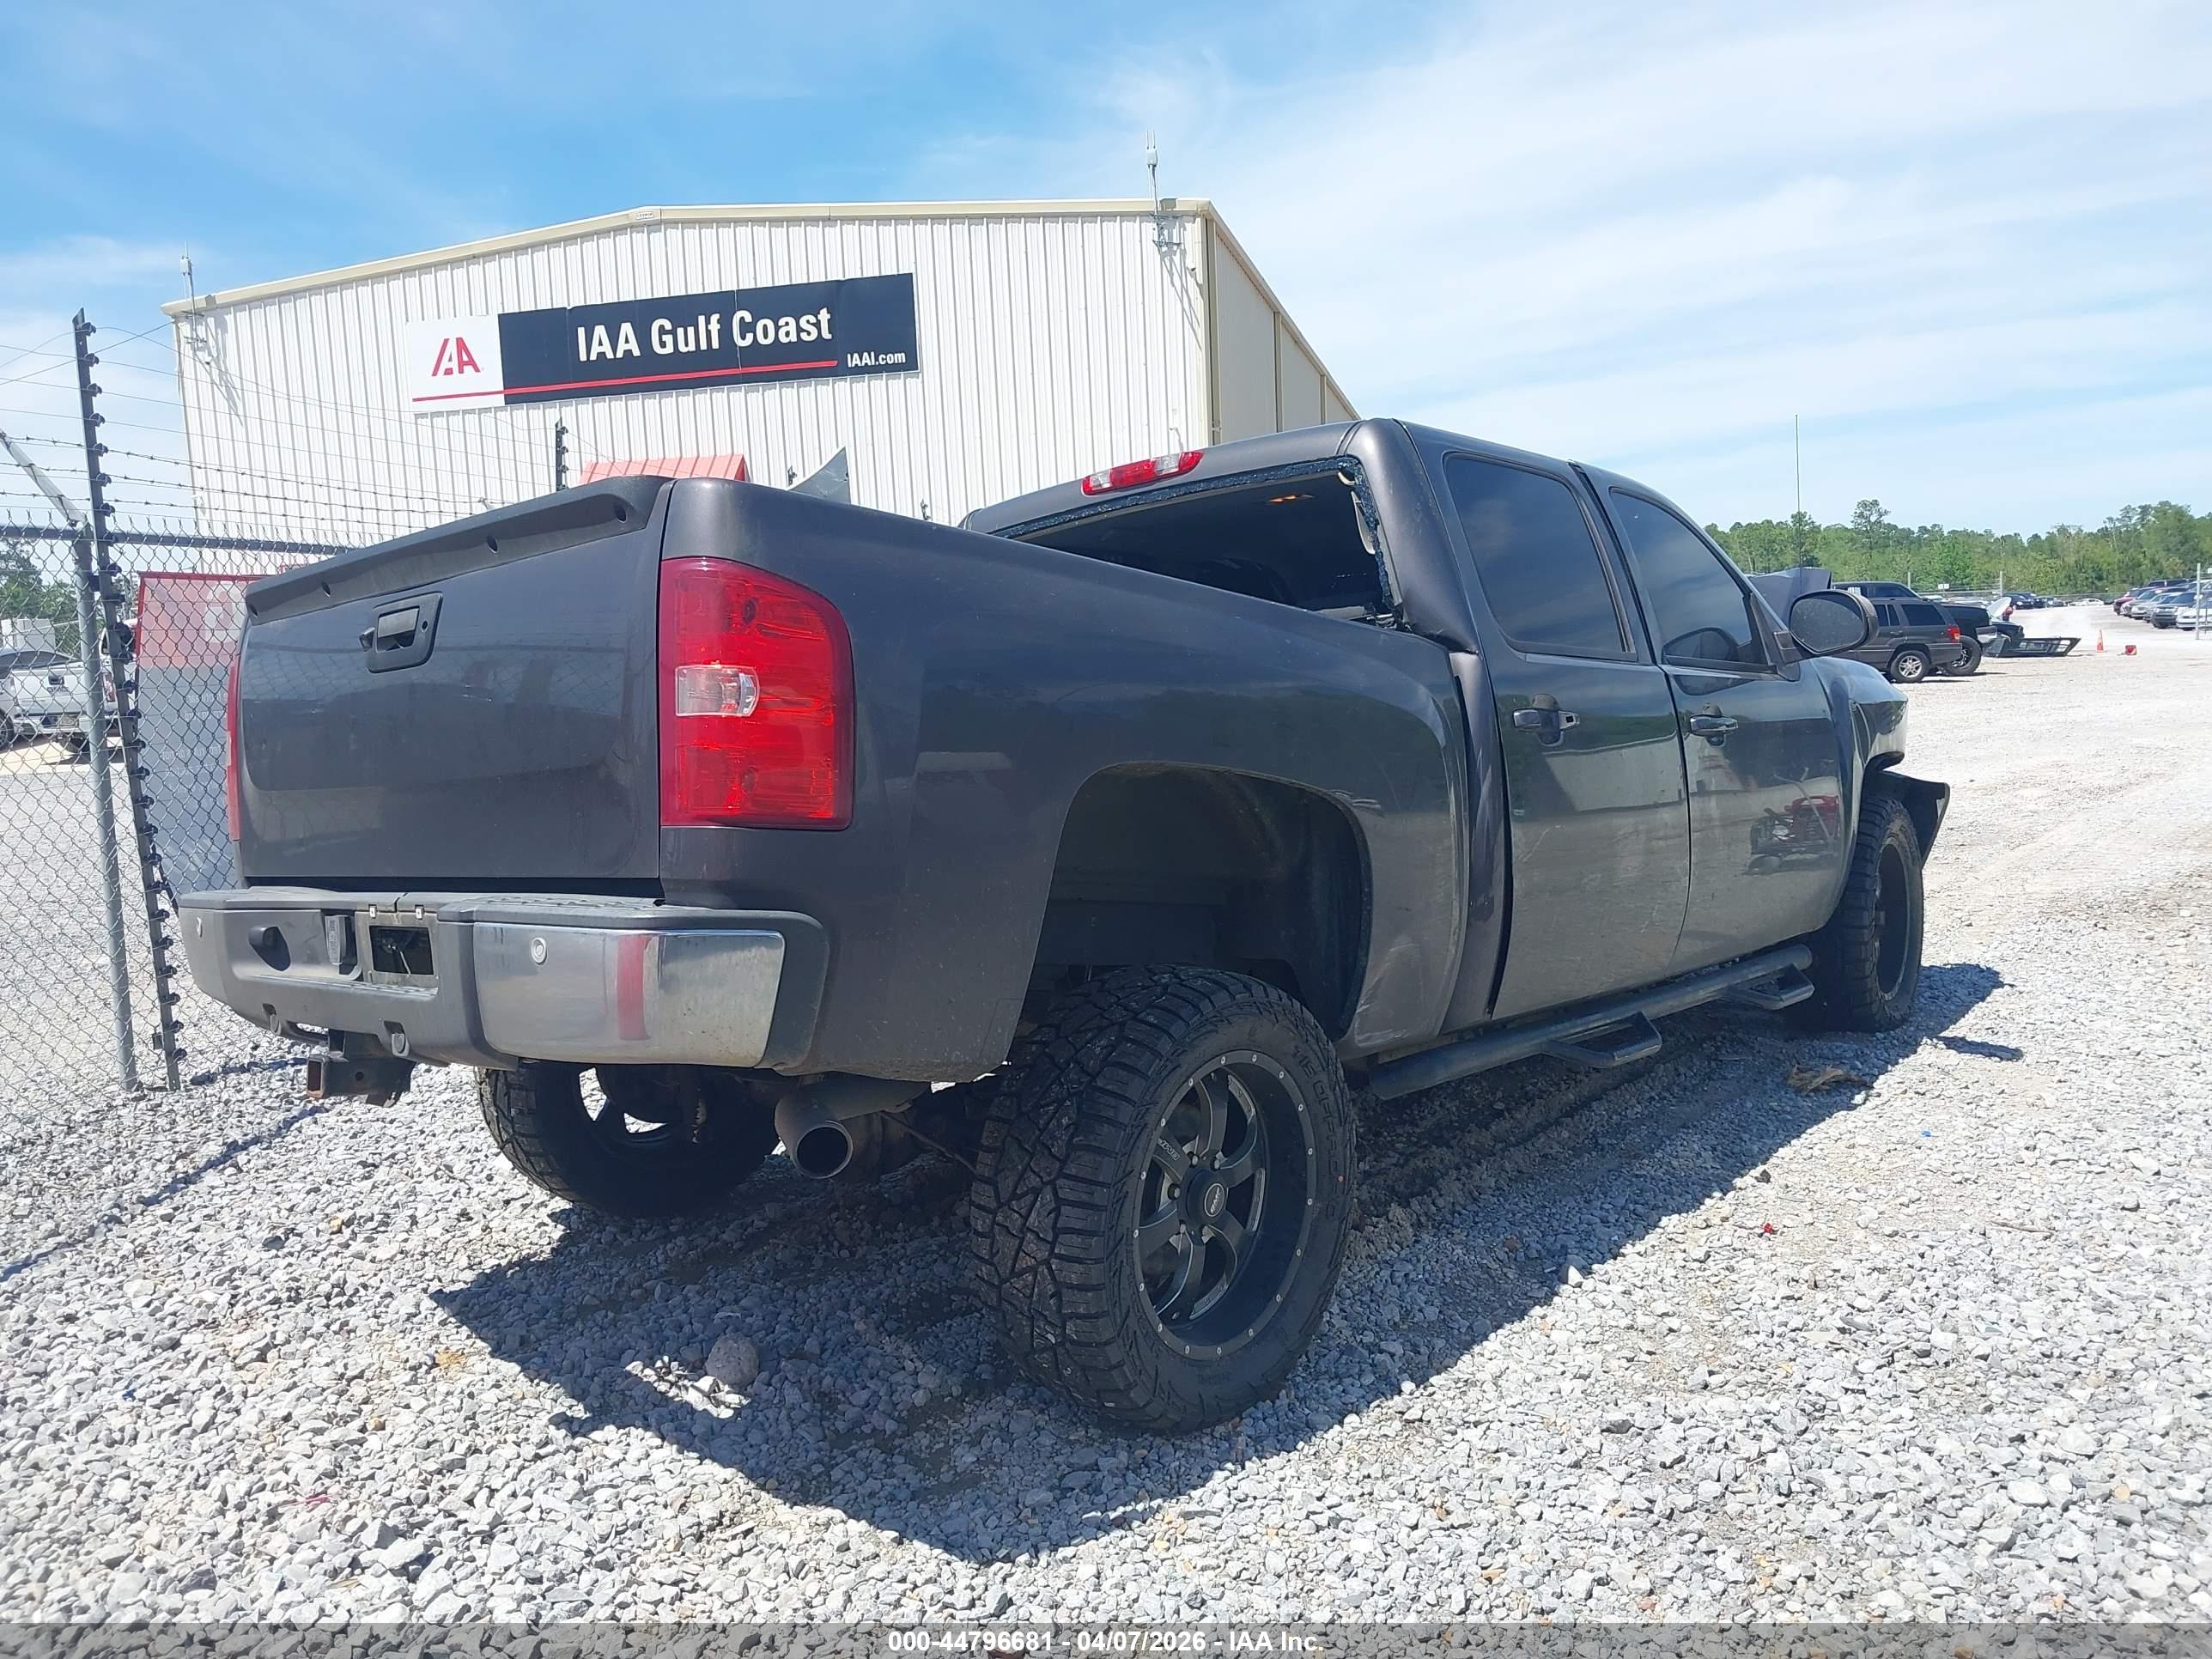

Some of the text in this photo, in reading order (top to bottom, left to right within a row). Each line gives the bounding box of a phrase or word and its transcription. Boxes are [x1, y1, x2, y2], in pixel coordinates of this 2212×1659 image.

[577, 305, 834, 362] IAA Gulf Coast
[846, 350, 907, 369] IAAI.com
